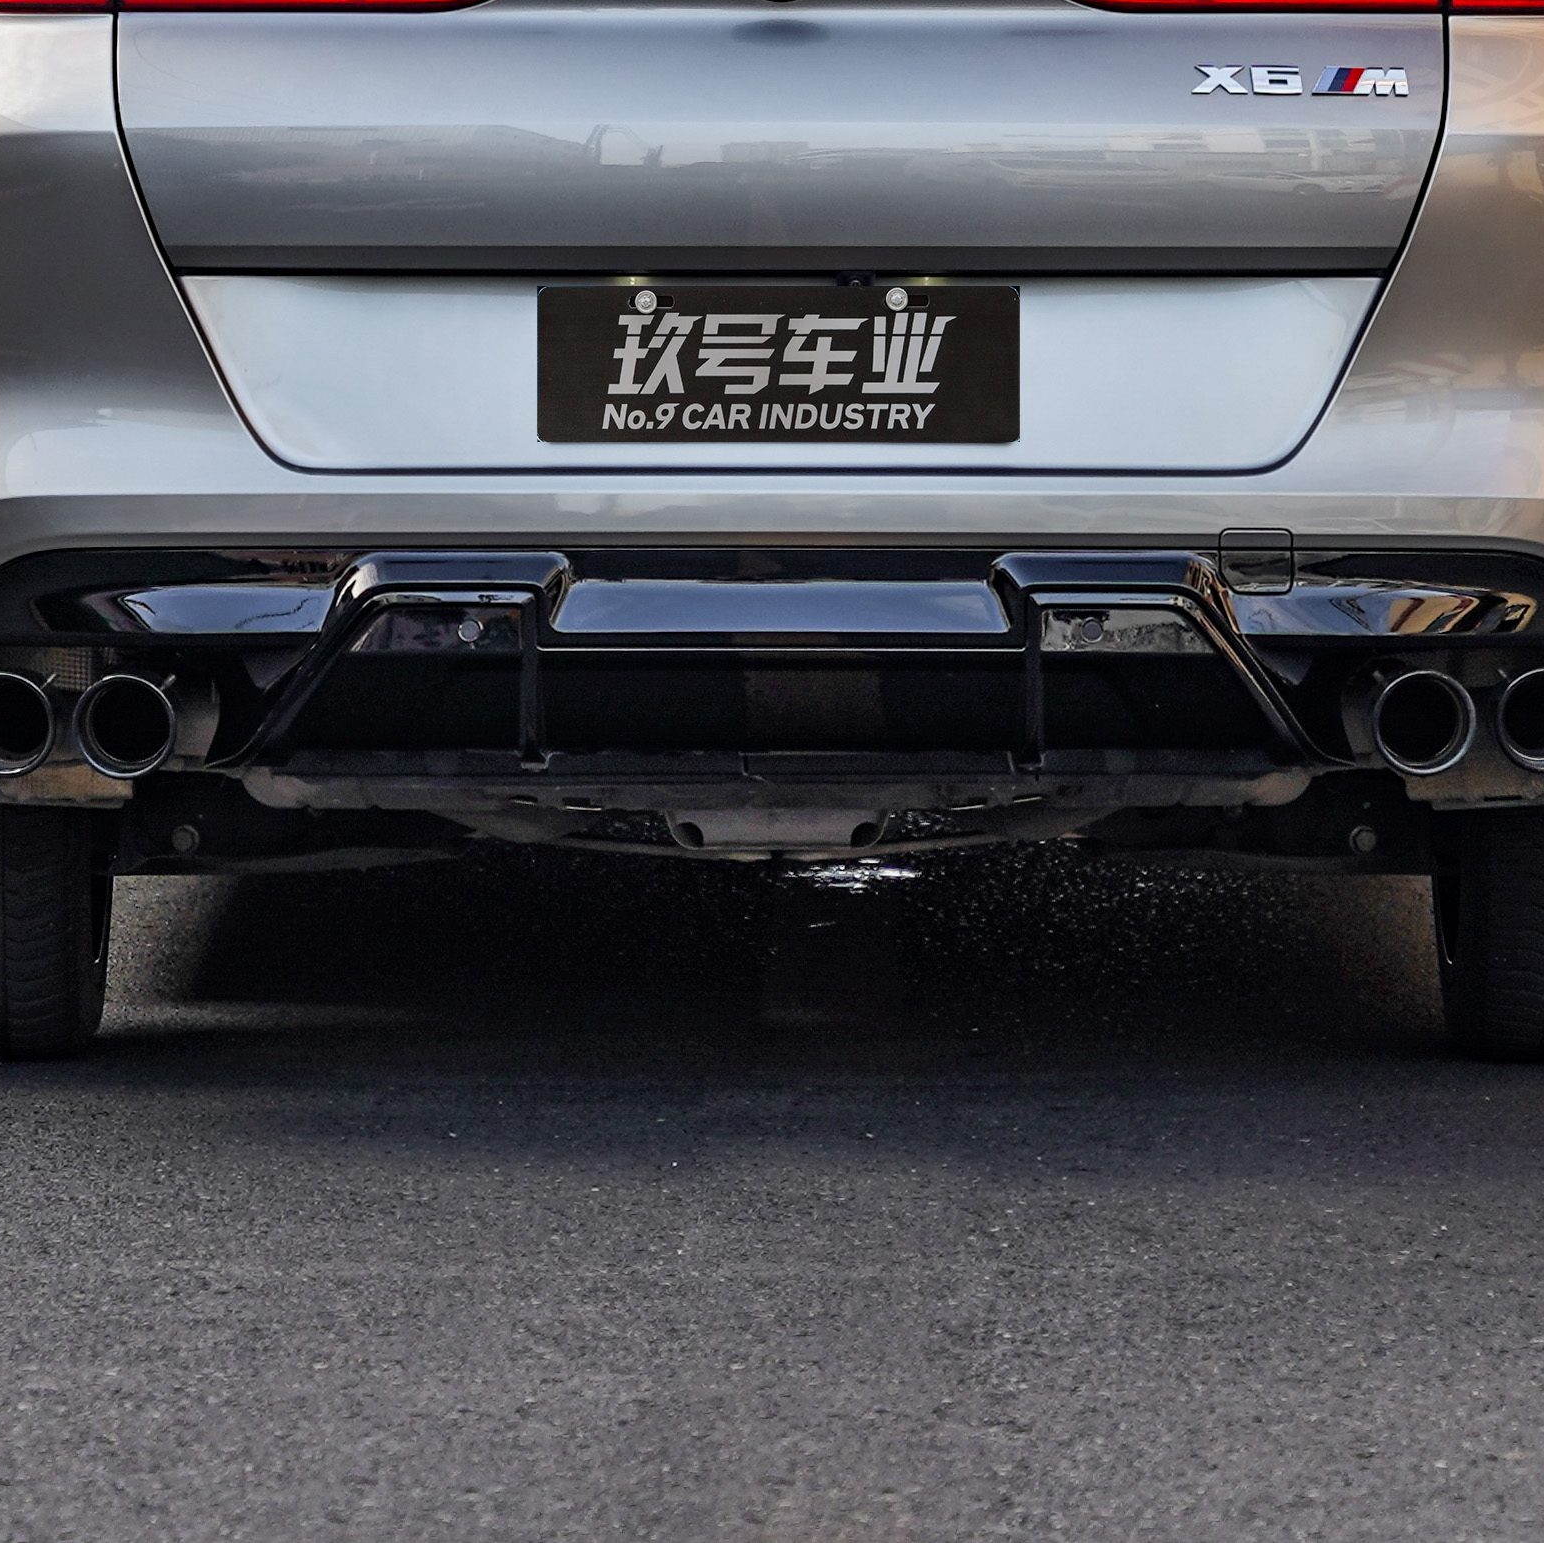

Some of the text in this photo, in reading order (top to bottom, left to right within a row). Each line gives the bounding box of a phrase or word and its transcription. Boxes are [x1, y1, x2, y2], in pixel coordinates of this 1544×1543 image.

[1191, 64, 1303, 95] X6
[607, 312, 957, 396] 玖号车业
[601, 402, 936, 430] No.9 CAR INDUSTRY
